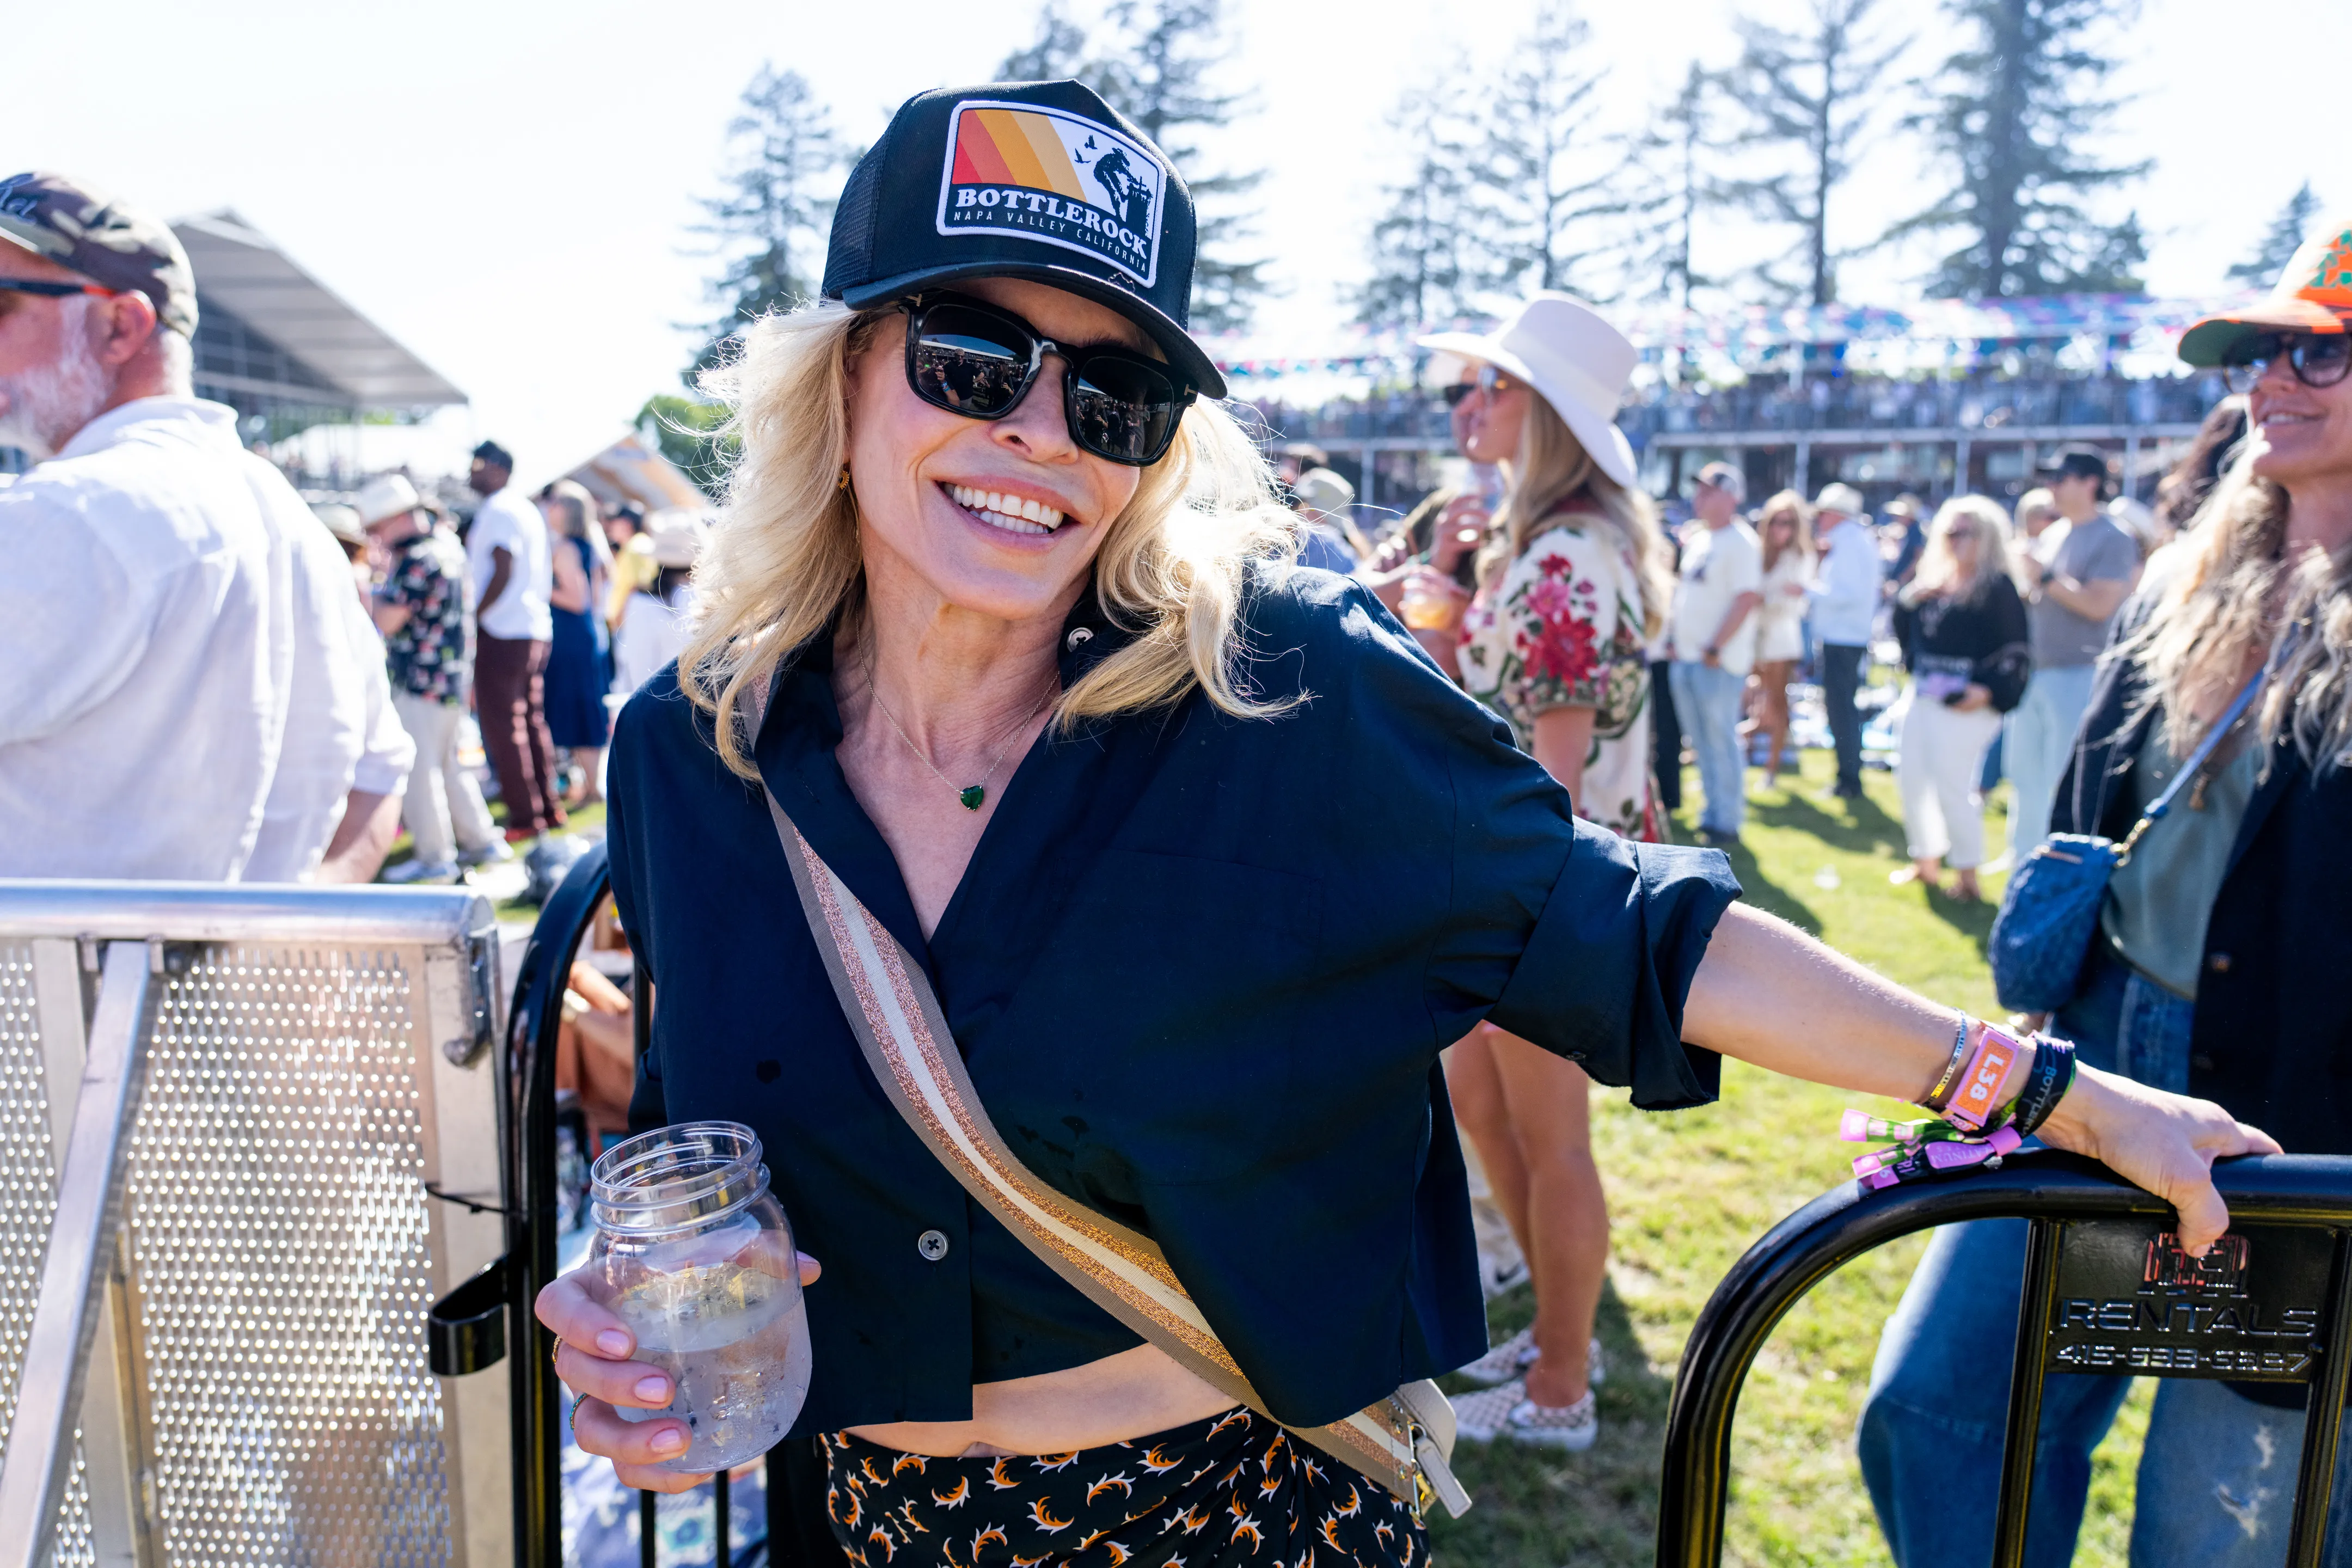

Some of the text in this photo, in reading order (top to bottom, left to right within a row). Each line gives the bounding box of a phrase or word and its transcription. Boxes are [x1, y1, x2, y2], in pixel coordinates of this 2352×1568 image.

[954, 211, 1147, 272] NAPA VALLEY CALIFORNIA
[955, 188, 1147, 259] BOTTLEROCK
[1970, 1053, 2004, 1100] L38
[2060, 1298, 2318, 1337] RENTALS
